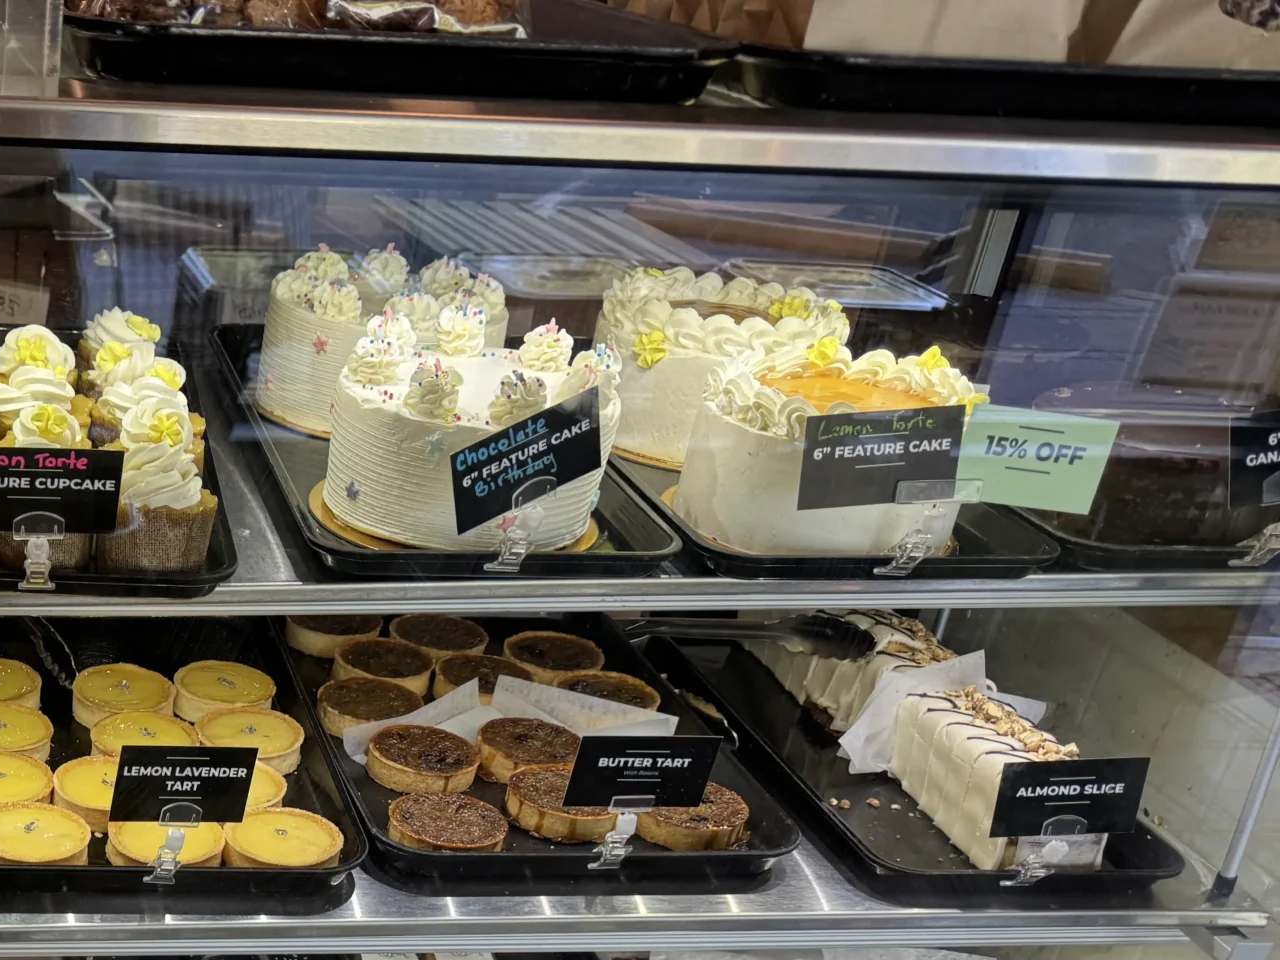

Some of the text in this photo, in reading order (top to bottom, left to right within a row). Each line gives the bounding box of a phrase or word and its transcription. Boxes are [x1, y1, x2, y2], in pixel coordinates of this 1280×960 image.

[886, 411, 936, 431] Torte
[456, 418, 549, 471] Chocolate
[482, 439, 548, 479] FEATURE
[550, 419, 591, 445] CAKE
[834, 441, 905, 459] FEATURE
[909, 438, 952, 453] CAKE
[984, 434, 1087, 465] 15% OFF
[34, 450, 88, 470] Torte
[1246, 450, 1280, 467] GAN
[34, 477, 116, 491] CUPCAKE
[474, 453, 557, 497] Birthday
[123, 766, 247, 778] LEMON LAVENDER
[598, 757, 692, 768] BUTTER TART
[165, 781, 201, 791] TART
[1015, 783, 1125, 798] ALMOND SLICE
